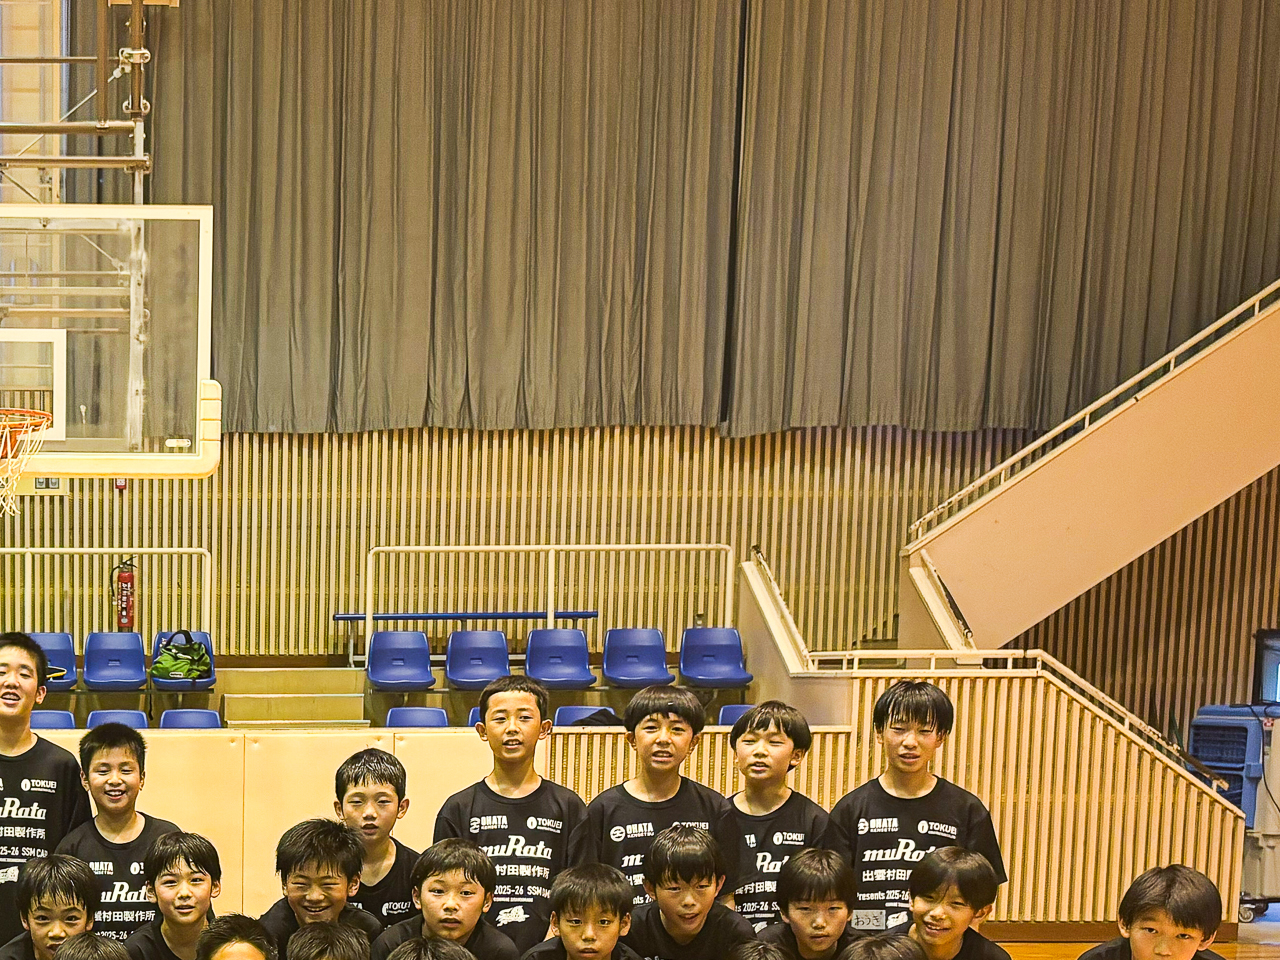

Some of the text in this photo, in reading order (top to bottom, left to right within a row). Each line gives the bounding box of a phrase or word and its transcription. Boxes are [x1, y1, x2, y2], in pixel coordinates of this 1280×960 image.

[494, 864, 550, 880] 村田製作所
